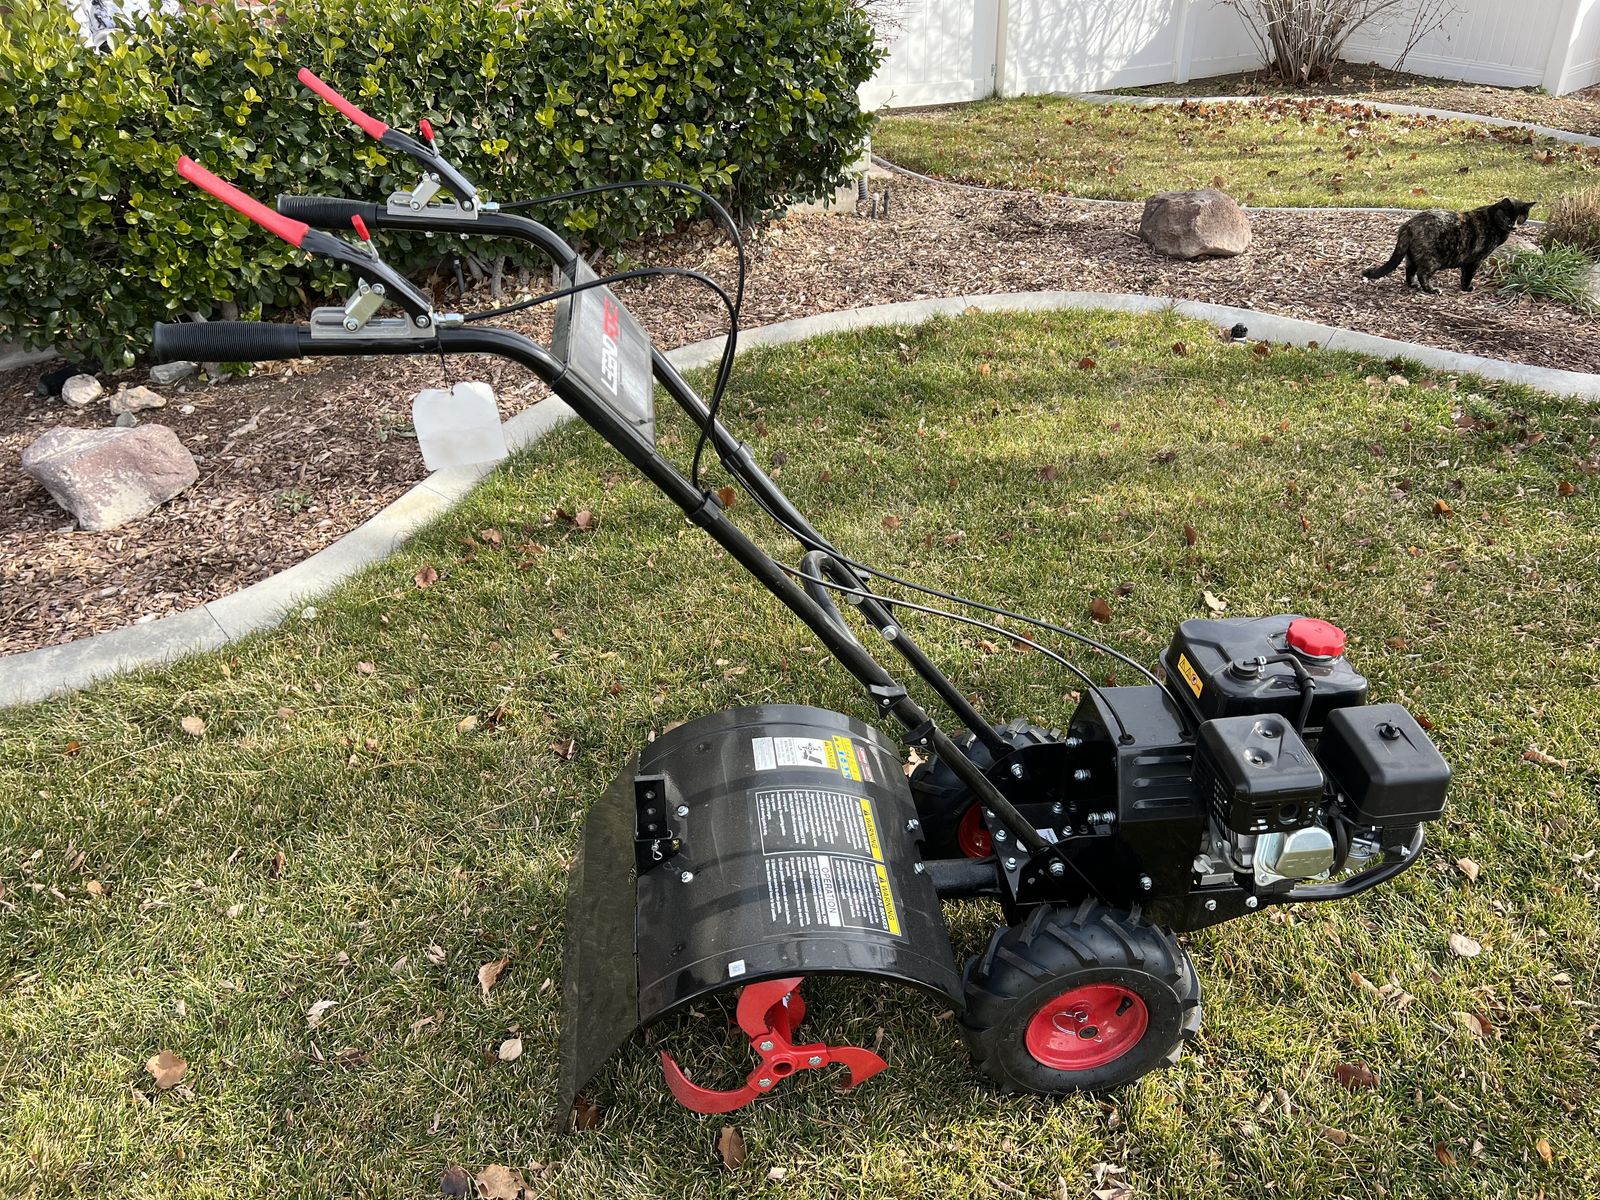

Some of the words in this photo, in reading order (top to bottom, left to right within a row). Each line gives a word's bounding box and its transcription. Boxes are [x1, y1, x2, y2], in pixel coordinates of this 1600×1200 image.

[864, 816, 877, 849] WARNING
[820, 867, 837, 913] OPERATION
[880, 884, 895, 920] WARNING
[878, 906, 888, 930] BRAKES
